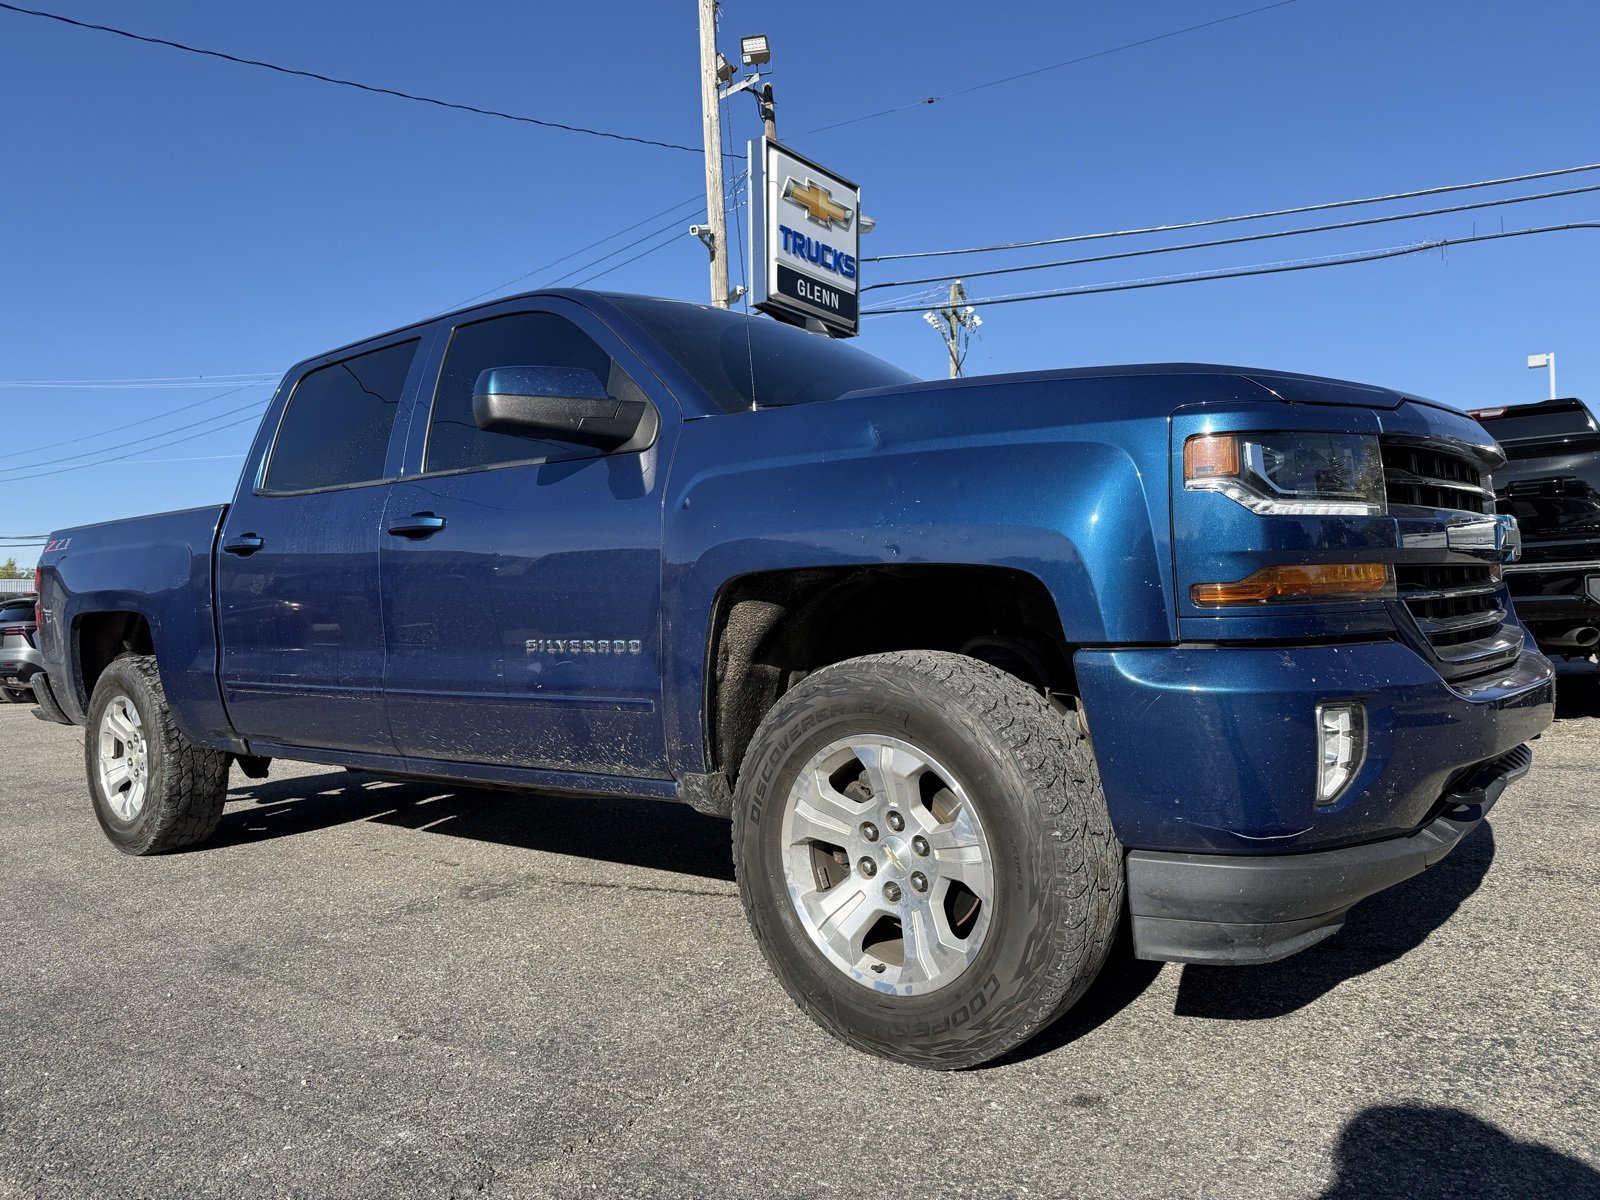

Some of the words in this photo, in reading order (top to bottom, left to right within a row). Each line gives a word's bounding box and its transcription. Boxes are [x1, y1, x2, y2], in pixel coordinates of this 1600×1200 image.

[780, 225, 855, 278] TRUCKS
[797, 279, 839, 309] GLENN
[45, 538, 72, 552] Z71
[526, 639, 641, 653] SILVERADO
[751, 703, 846, 826] DISCOVERER
